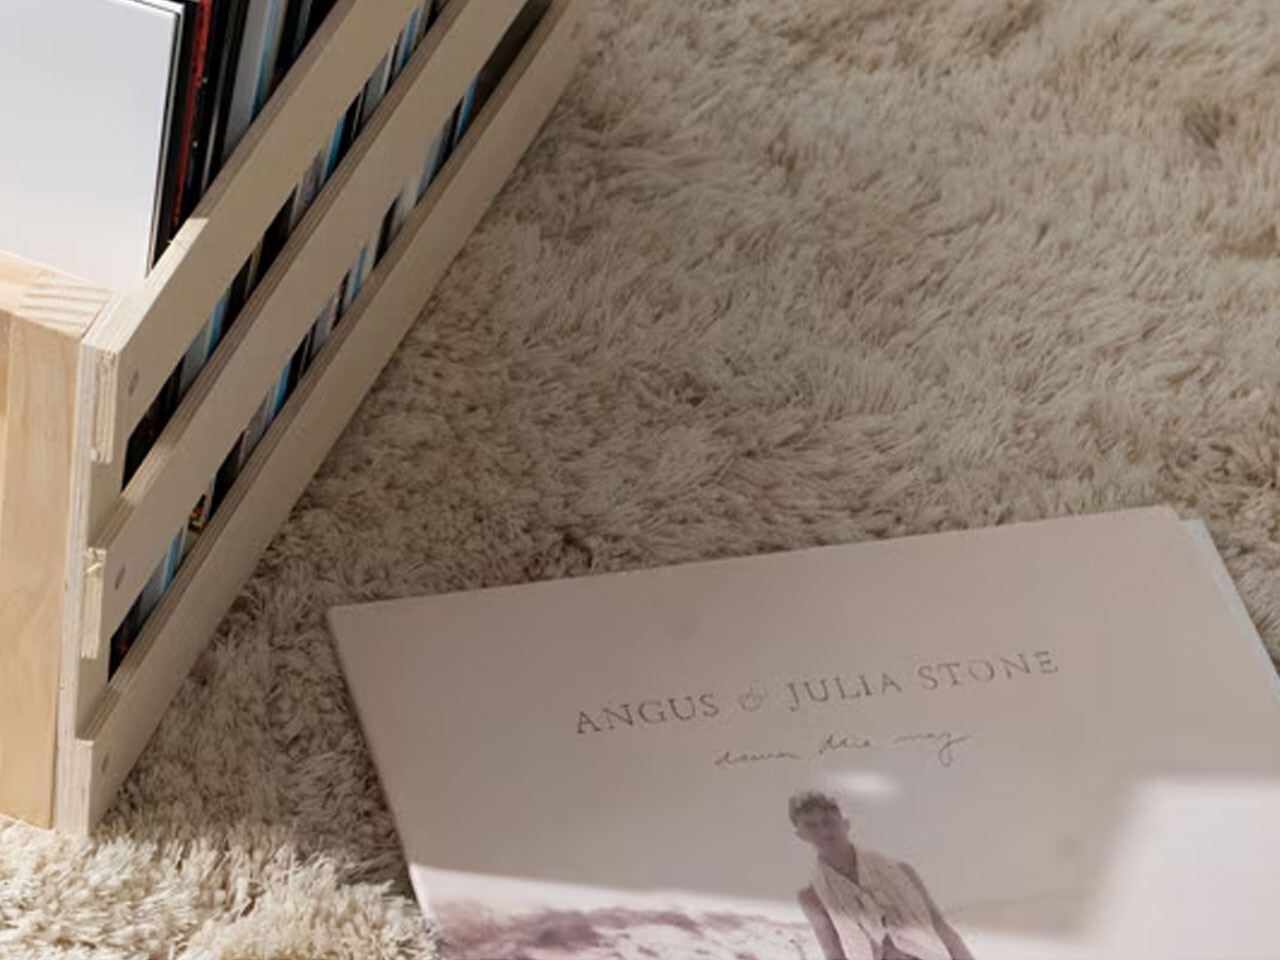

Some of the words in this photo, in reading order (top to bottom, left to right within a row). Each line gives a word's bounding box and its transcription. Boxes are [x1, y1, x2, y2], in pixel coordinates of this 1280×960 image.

[575, 692, 721, 735] ANGUS
[786, 672, 904, 713] JULIA
[917, 650, 1059, 691] STONE
